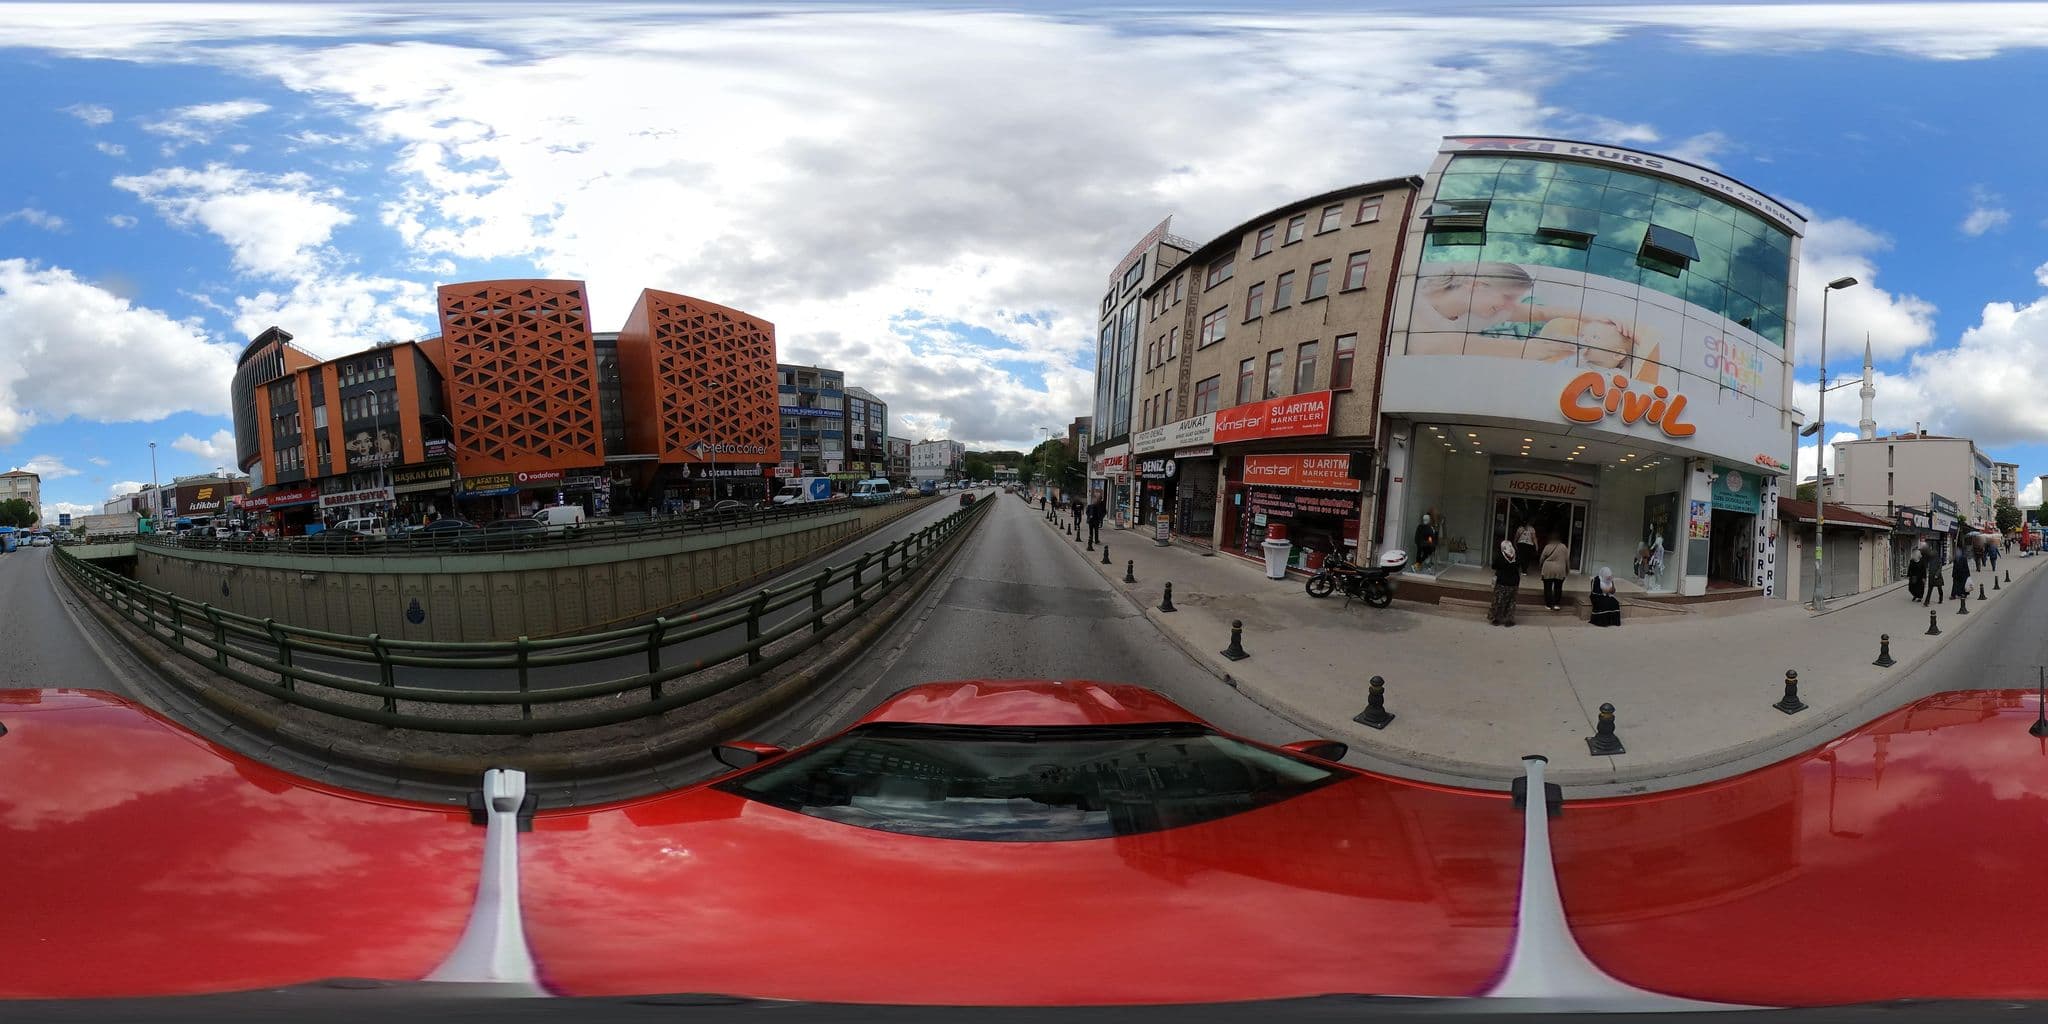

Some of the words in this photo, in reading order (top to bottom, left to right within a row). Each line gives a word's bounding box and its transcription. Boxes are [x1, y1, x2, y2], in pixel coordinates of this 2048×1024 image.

[1570, 146, 1666, 170] KURS
[1699, 176, 1734, 193] 0216
[1738, 191, 1762, 206] 420
[1271, 405, 1284, 416] SU
[1286, 400, 1324, 414] ARITMA
[1178, 416, 1208, 431] AVUKAT
[1216, 416, 1262, 432] Kimstar
[1270, 412, 1324, 424] MARKETLERİ
[1142, 460, 1165, 473] DENİZ
[1246, 460, 1291, 475] Kimstar
[1303, 459, 1314, 468] SU
[428, 466, 450, 478] GİYİM
[528, 471, 560, 480] vodafone
[189, 500, 220, 511] istikbal
[1757, 526, 1765, 587] KURS
[1766, 537, 1775, 596] KURS
